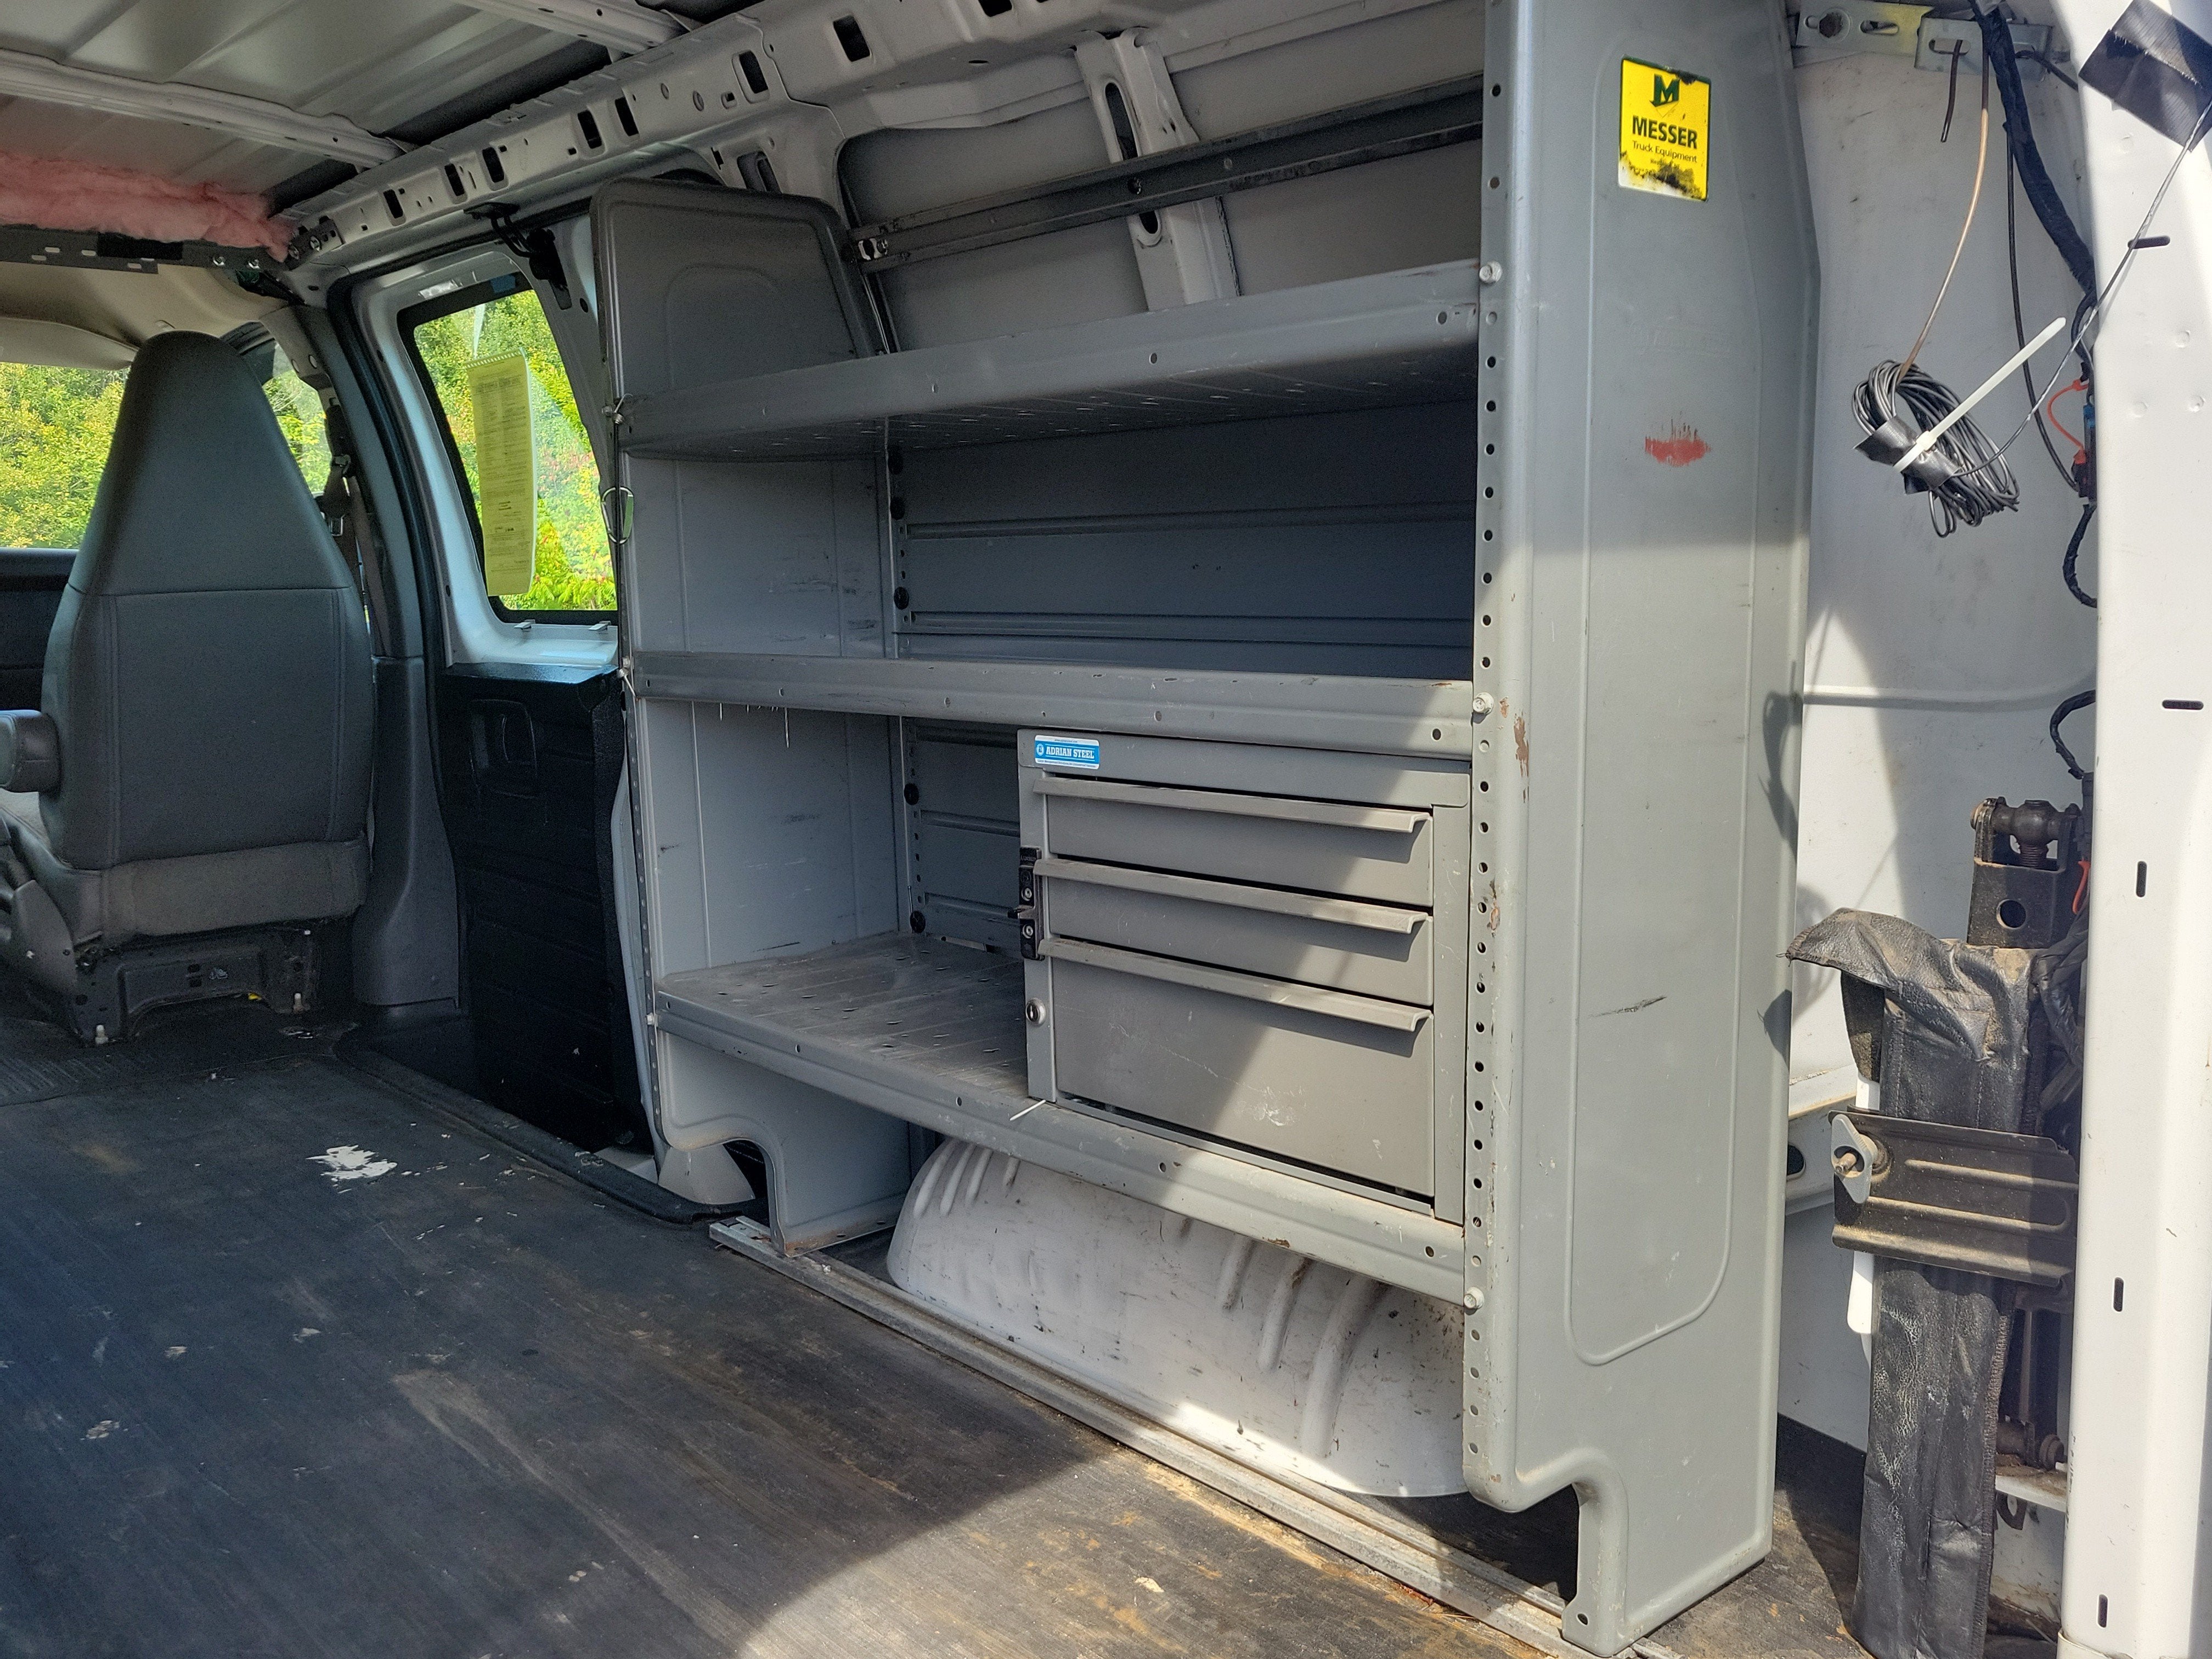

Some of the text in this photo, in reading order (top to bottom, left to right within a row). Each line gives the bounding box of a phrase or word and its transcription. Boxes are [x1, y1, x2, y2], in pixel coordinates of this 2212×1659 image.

[1650, 74, 1680, 107] M
[1633, 116, 1697, 149] MESSER
[1633, 141, 1697, 162] Truck Equipment
[1046, 747, 1094, 759] ADRIAN STEEL
